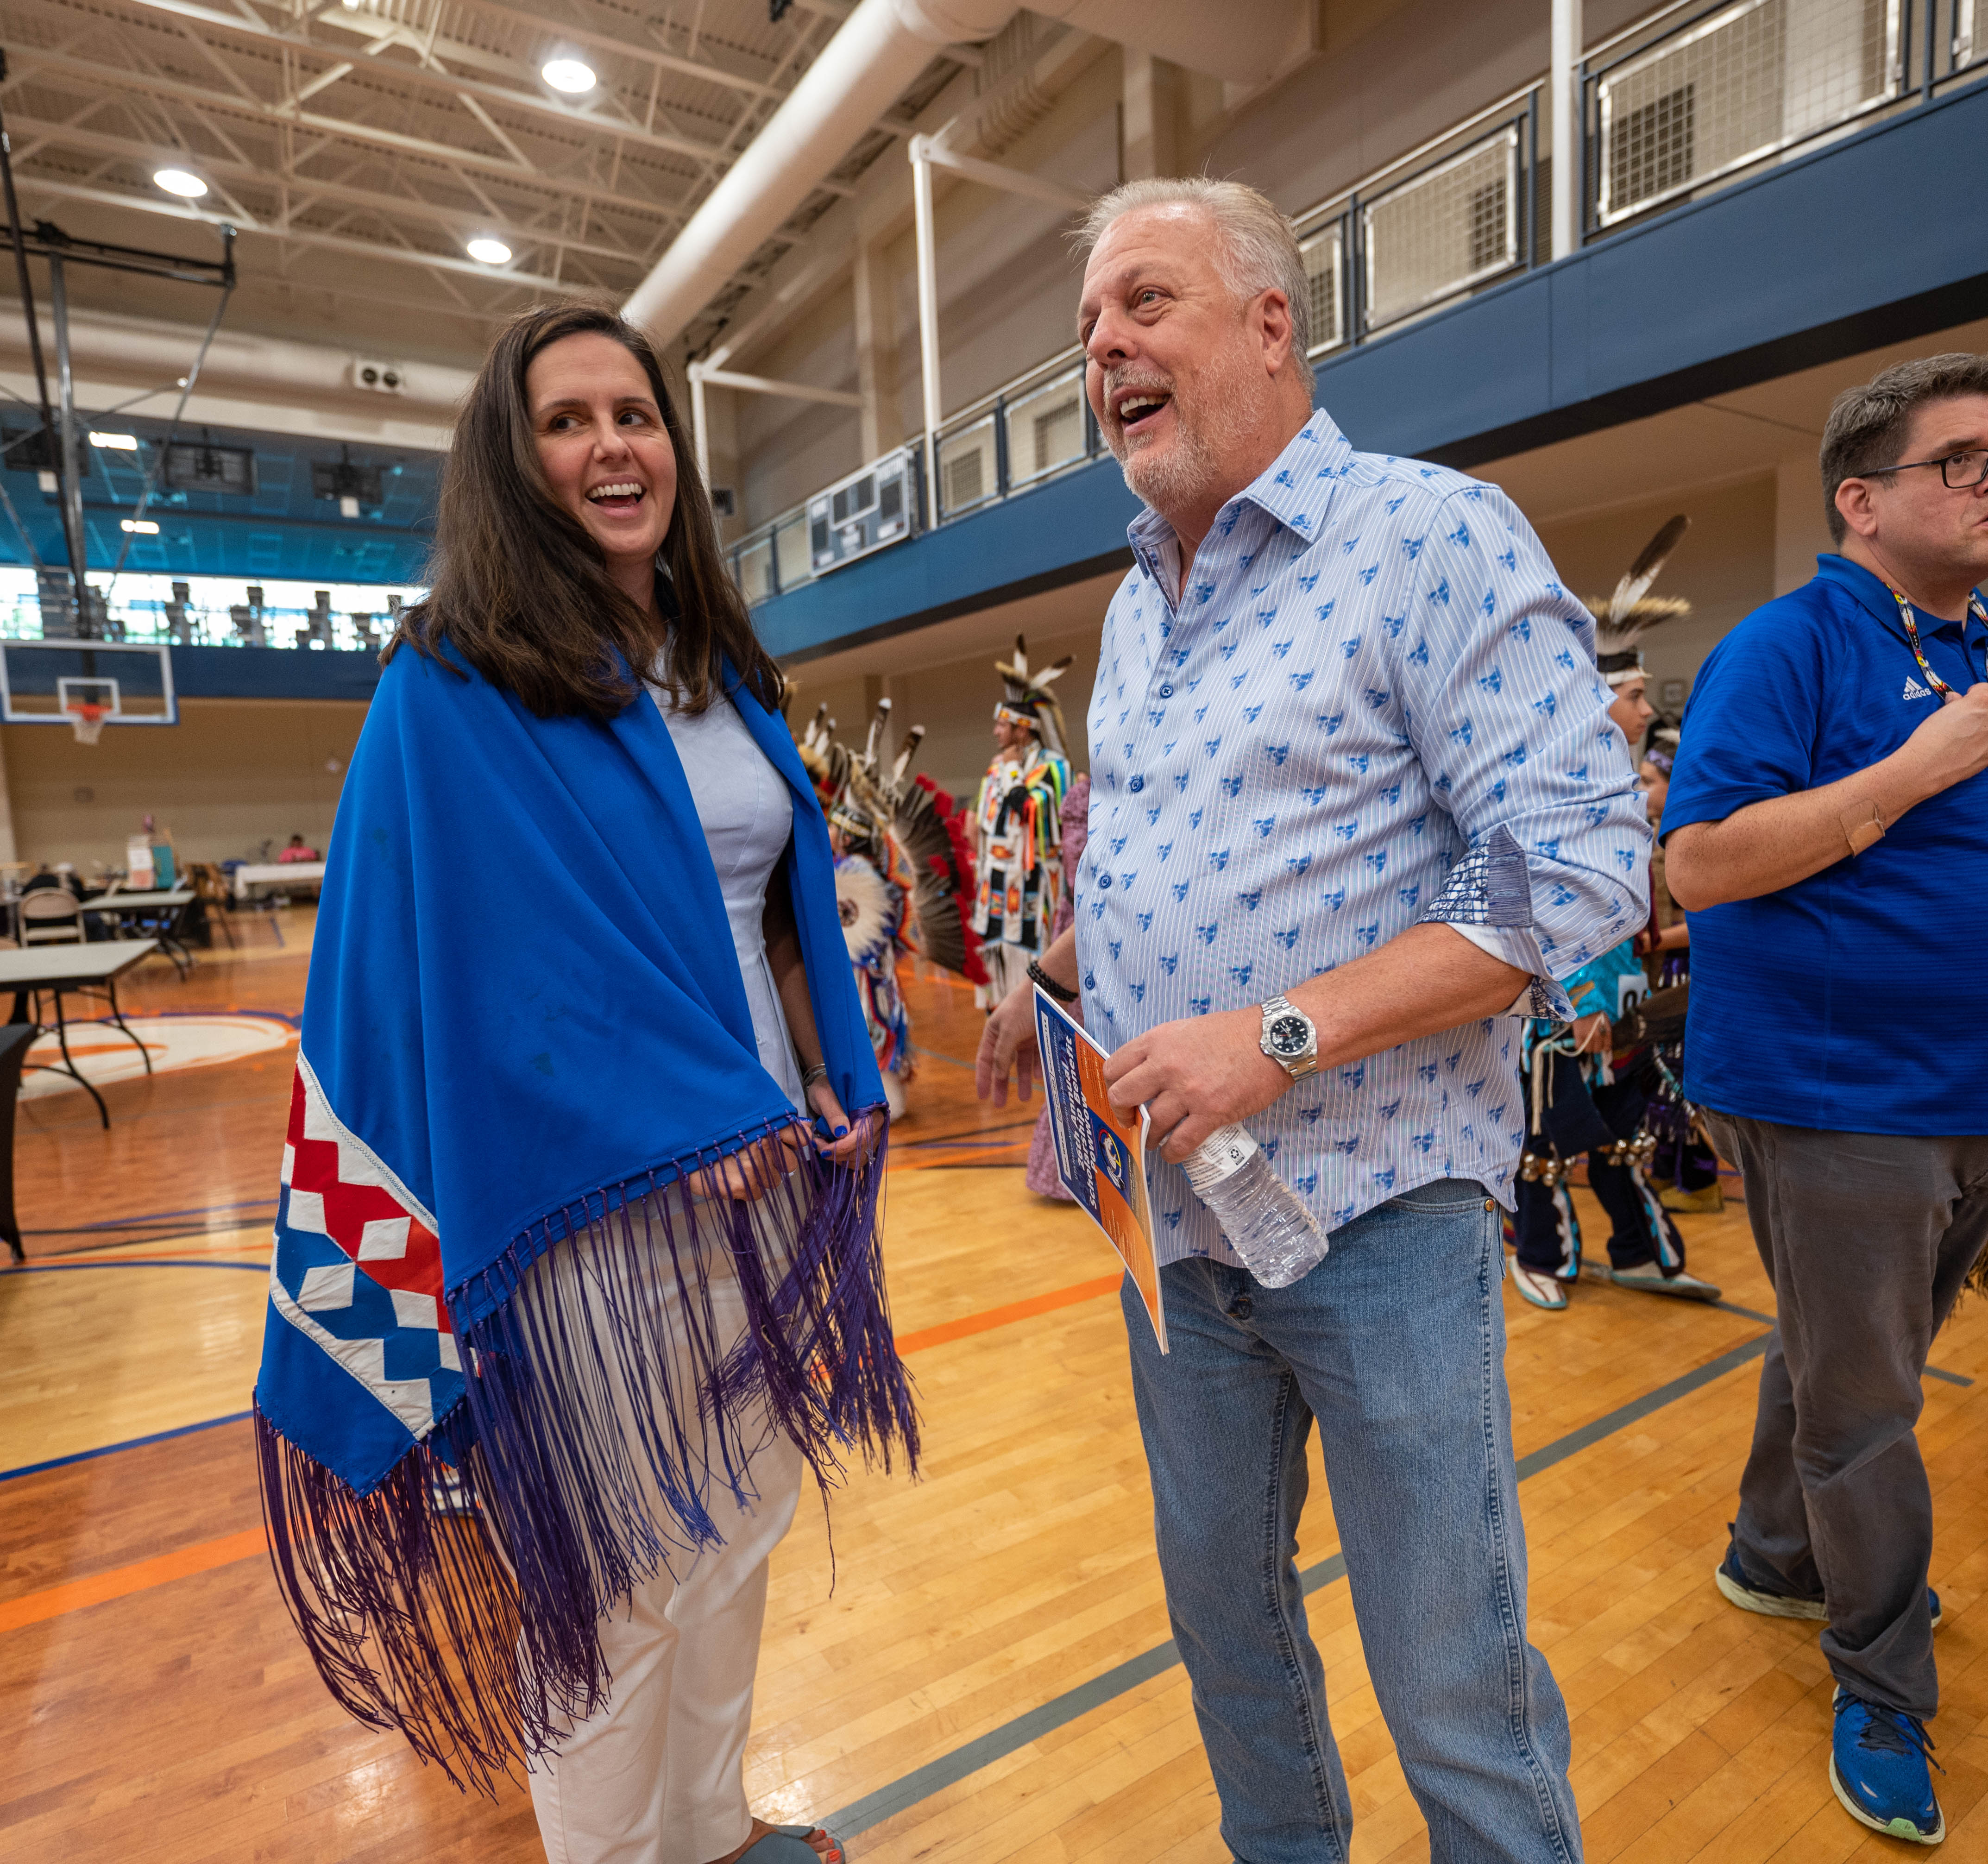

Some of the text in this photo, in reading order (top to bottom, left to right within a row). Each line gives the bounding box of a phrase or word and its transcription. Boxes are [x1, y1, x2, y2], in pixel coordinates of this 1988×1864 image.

[1903, 688, 1931, 700] adidas
[1053, 1032, 1061, 1075] Association
[1066, 1035, 1081, 1105] Benefit
[1062, 1061, 1085, 1171] 26th Annual
[1063, 1106, 1072, 1141] American
[1081, 1090, 1098, 1174] Powwow
[1076, 1108, 1097, 1209] Scholarship
